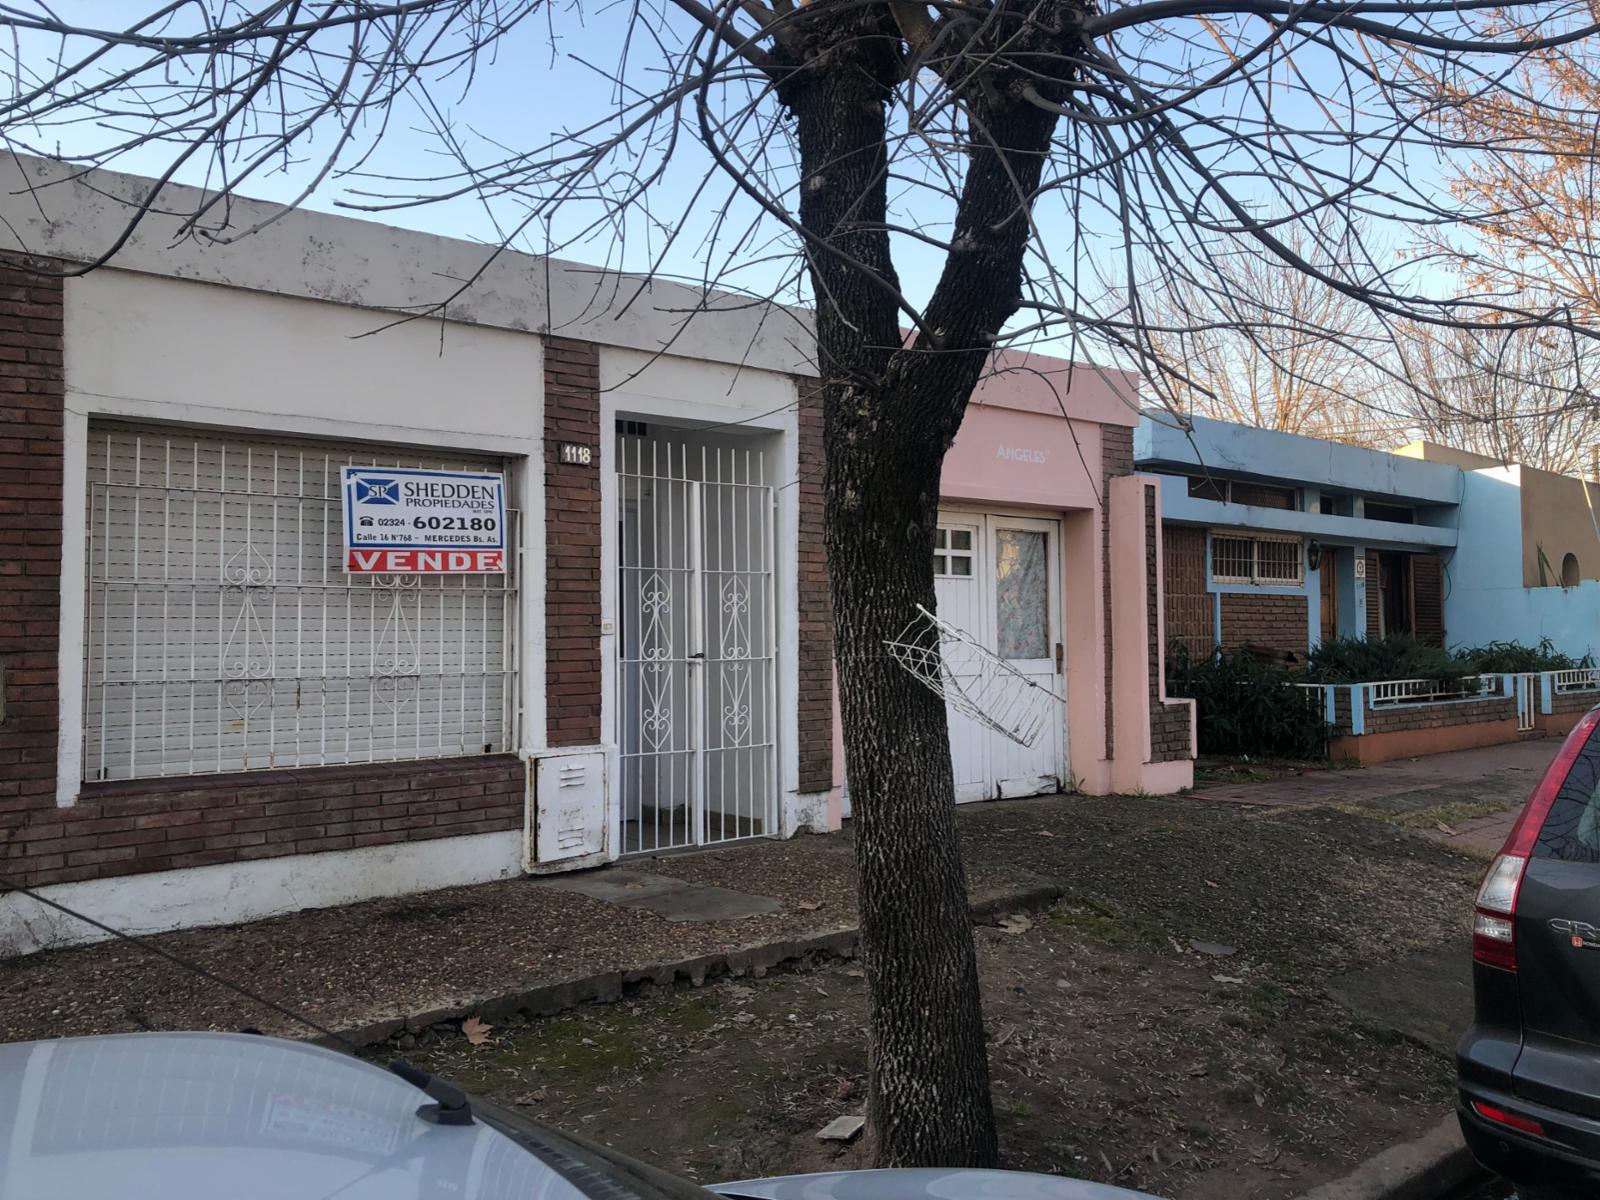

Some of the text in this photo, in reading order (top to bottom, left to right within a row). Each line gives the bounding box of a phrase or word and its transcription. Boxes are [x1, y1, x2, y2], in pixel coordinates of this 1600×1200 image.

[565, 445, 591, 464] 1118
[368, 484, 387, 497] SP
[404, 482, 495, 500] SHEDDEN
[405, 497, 495, 510] PROPIEDADES
[377, 518, 405, 527] 02324
[413, 516, 496, 531] 602180
[356, 533, 377, 541] Calle
[379, 533, 389, 541] 16
[424, 534, 471, 542] MERCEDES
[473, 535, 485, 543] Bs.
[352, 551, 499, 571] VENDE
